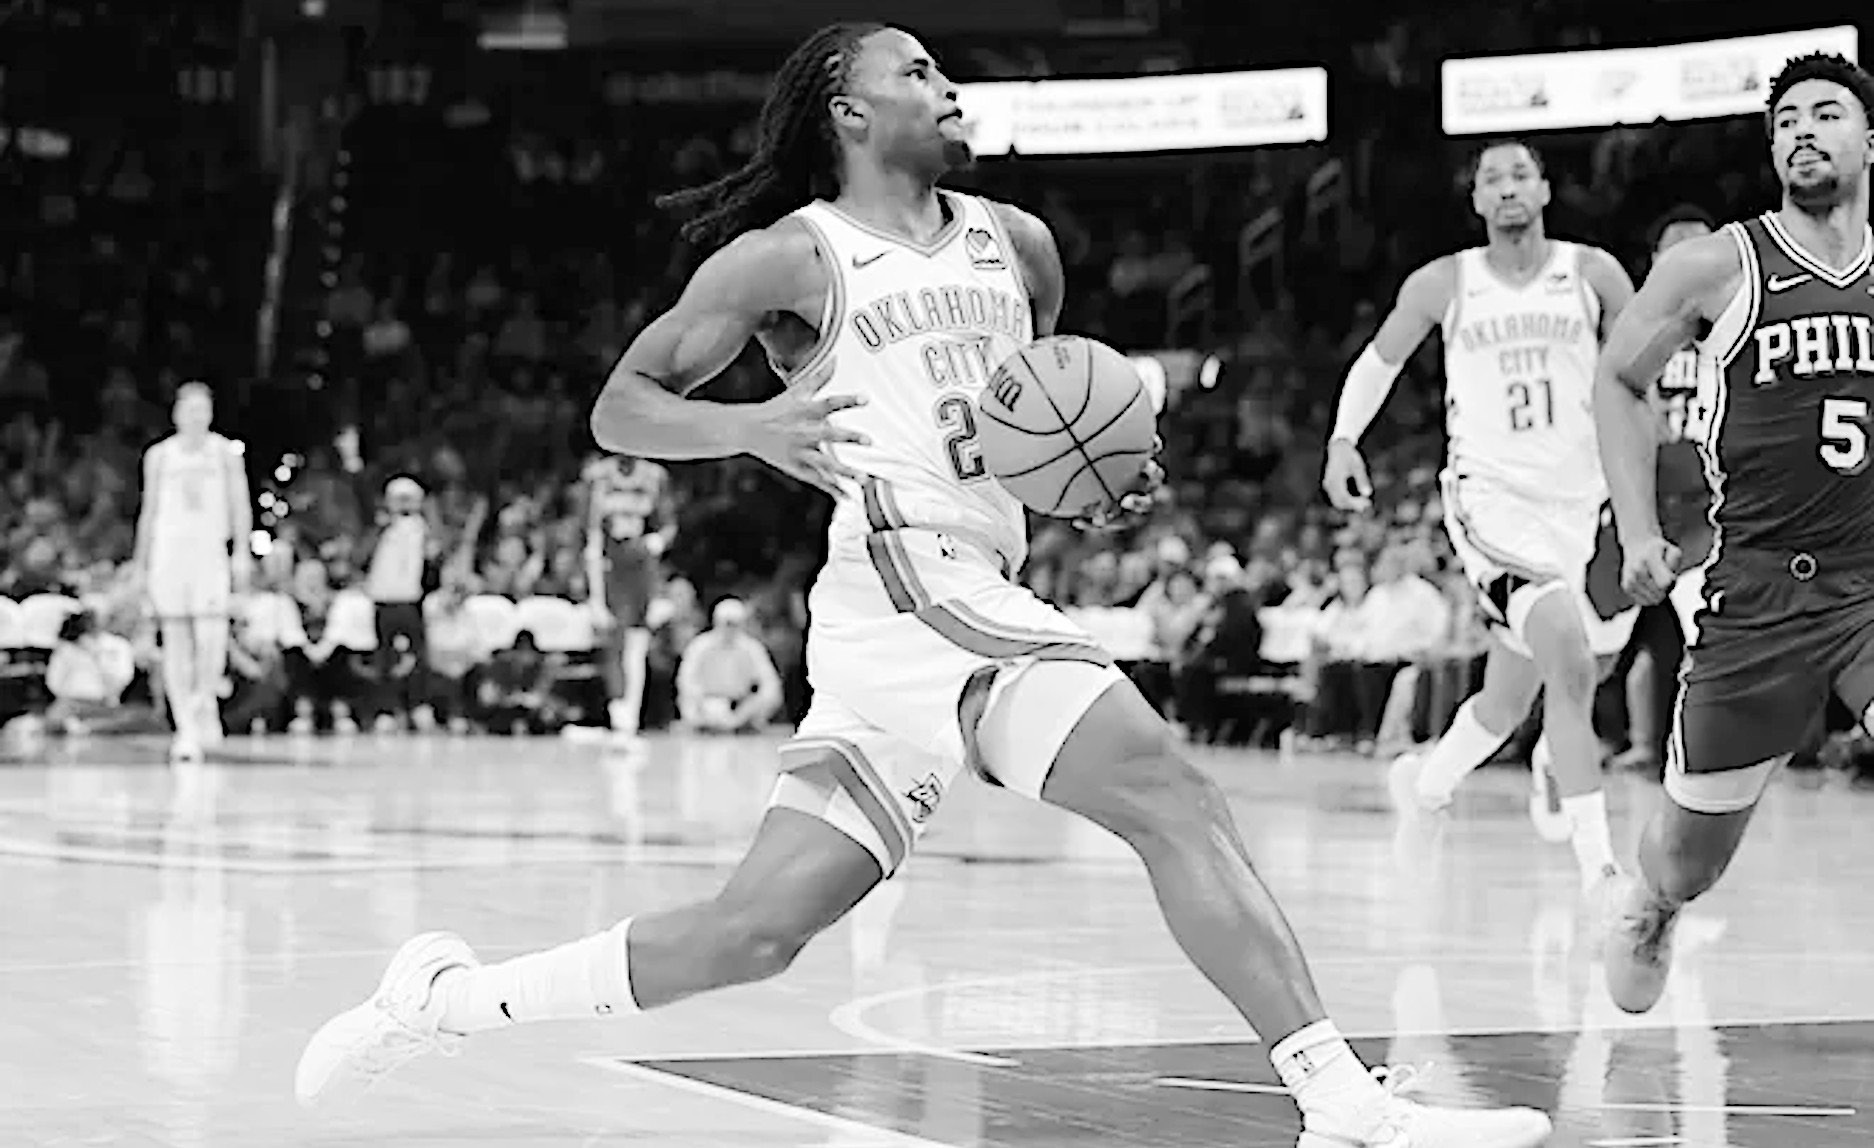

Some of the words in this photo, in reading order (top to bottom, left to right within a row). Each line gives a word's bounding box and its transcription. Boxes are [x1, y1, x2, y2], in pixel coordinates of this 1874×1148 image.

[850, 286, 1029, 352] OKLAHOMA
[1460, 313, 1583, 351] OKLAHOMA
[921, 336, 992, 388] CITY
[1499, 346, 1549, 375] CITY
[1754, 314, 1874, 388] PHIL
[1507, 378, 1553, 431] 21
[1820, 399, 1871, 475] 5
